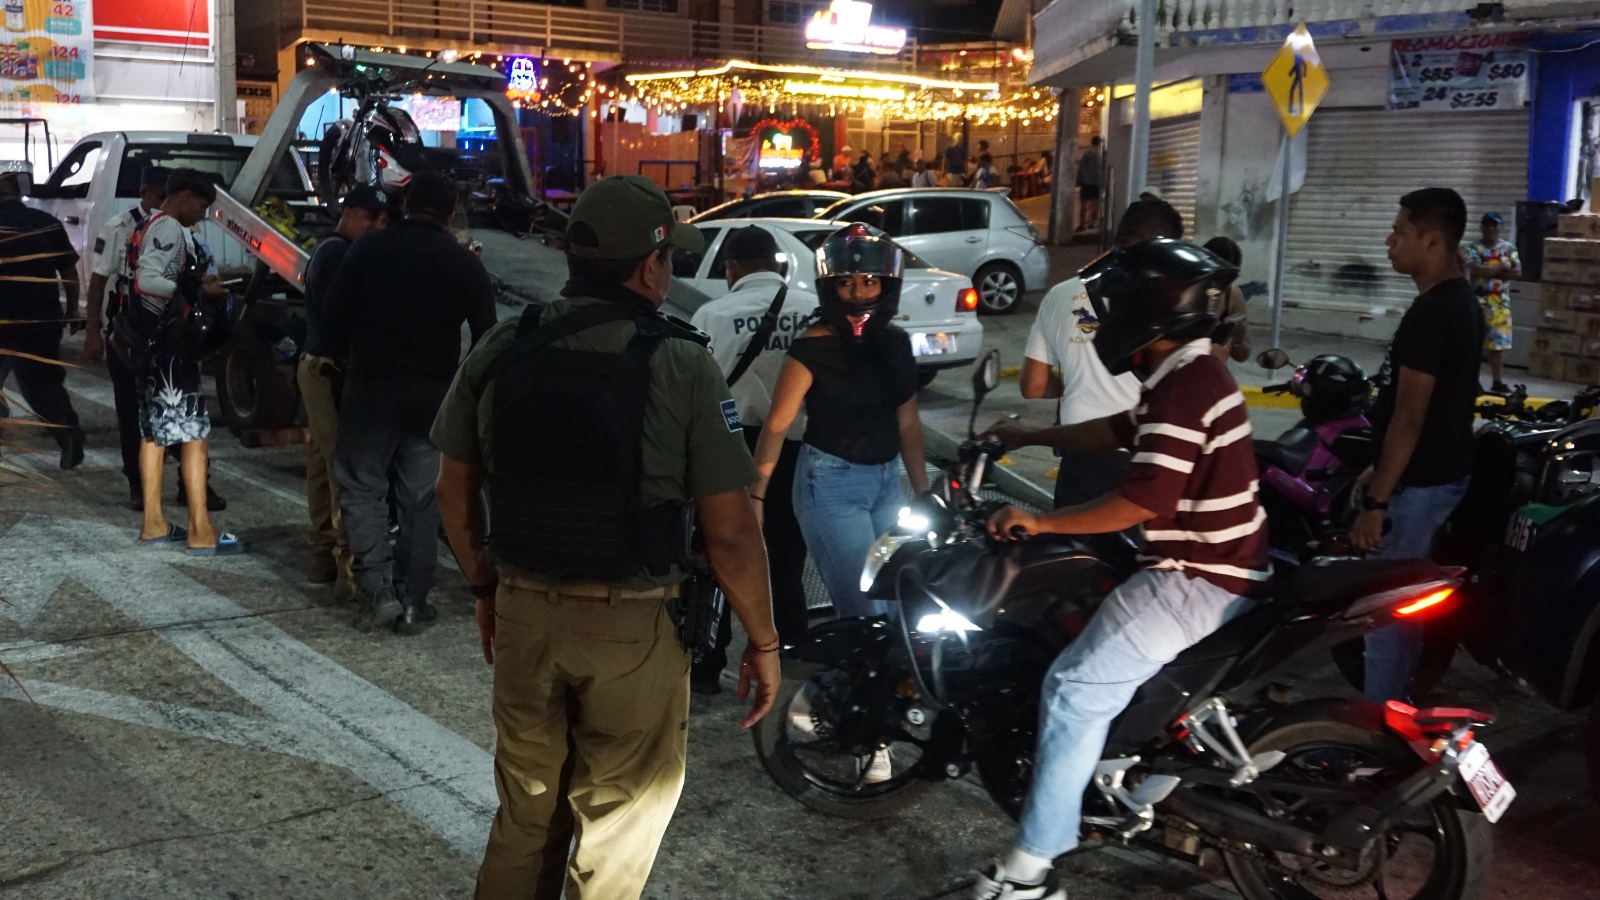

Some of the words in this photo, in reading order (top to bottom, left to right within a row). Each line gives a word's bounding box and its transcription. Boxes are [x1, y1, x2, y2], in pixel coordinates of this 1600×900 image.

[52, 3, 74, 17] 42
[1391, 33, 1529, 53] PROMOCIONE
[51, 46, 79, 59] 124
[53, 94, 81, 105] 124
[733, 312, 811, 335] POCÍA
